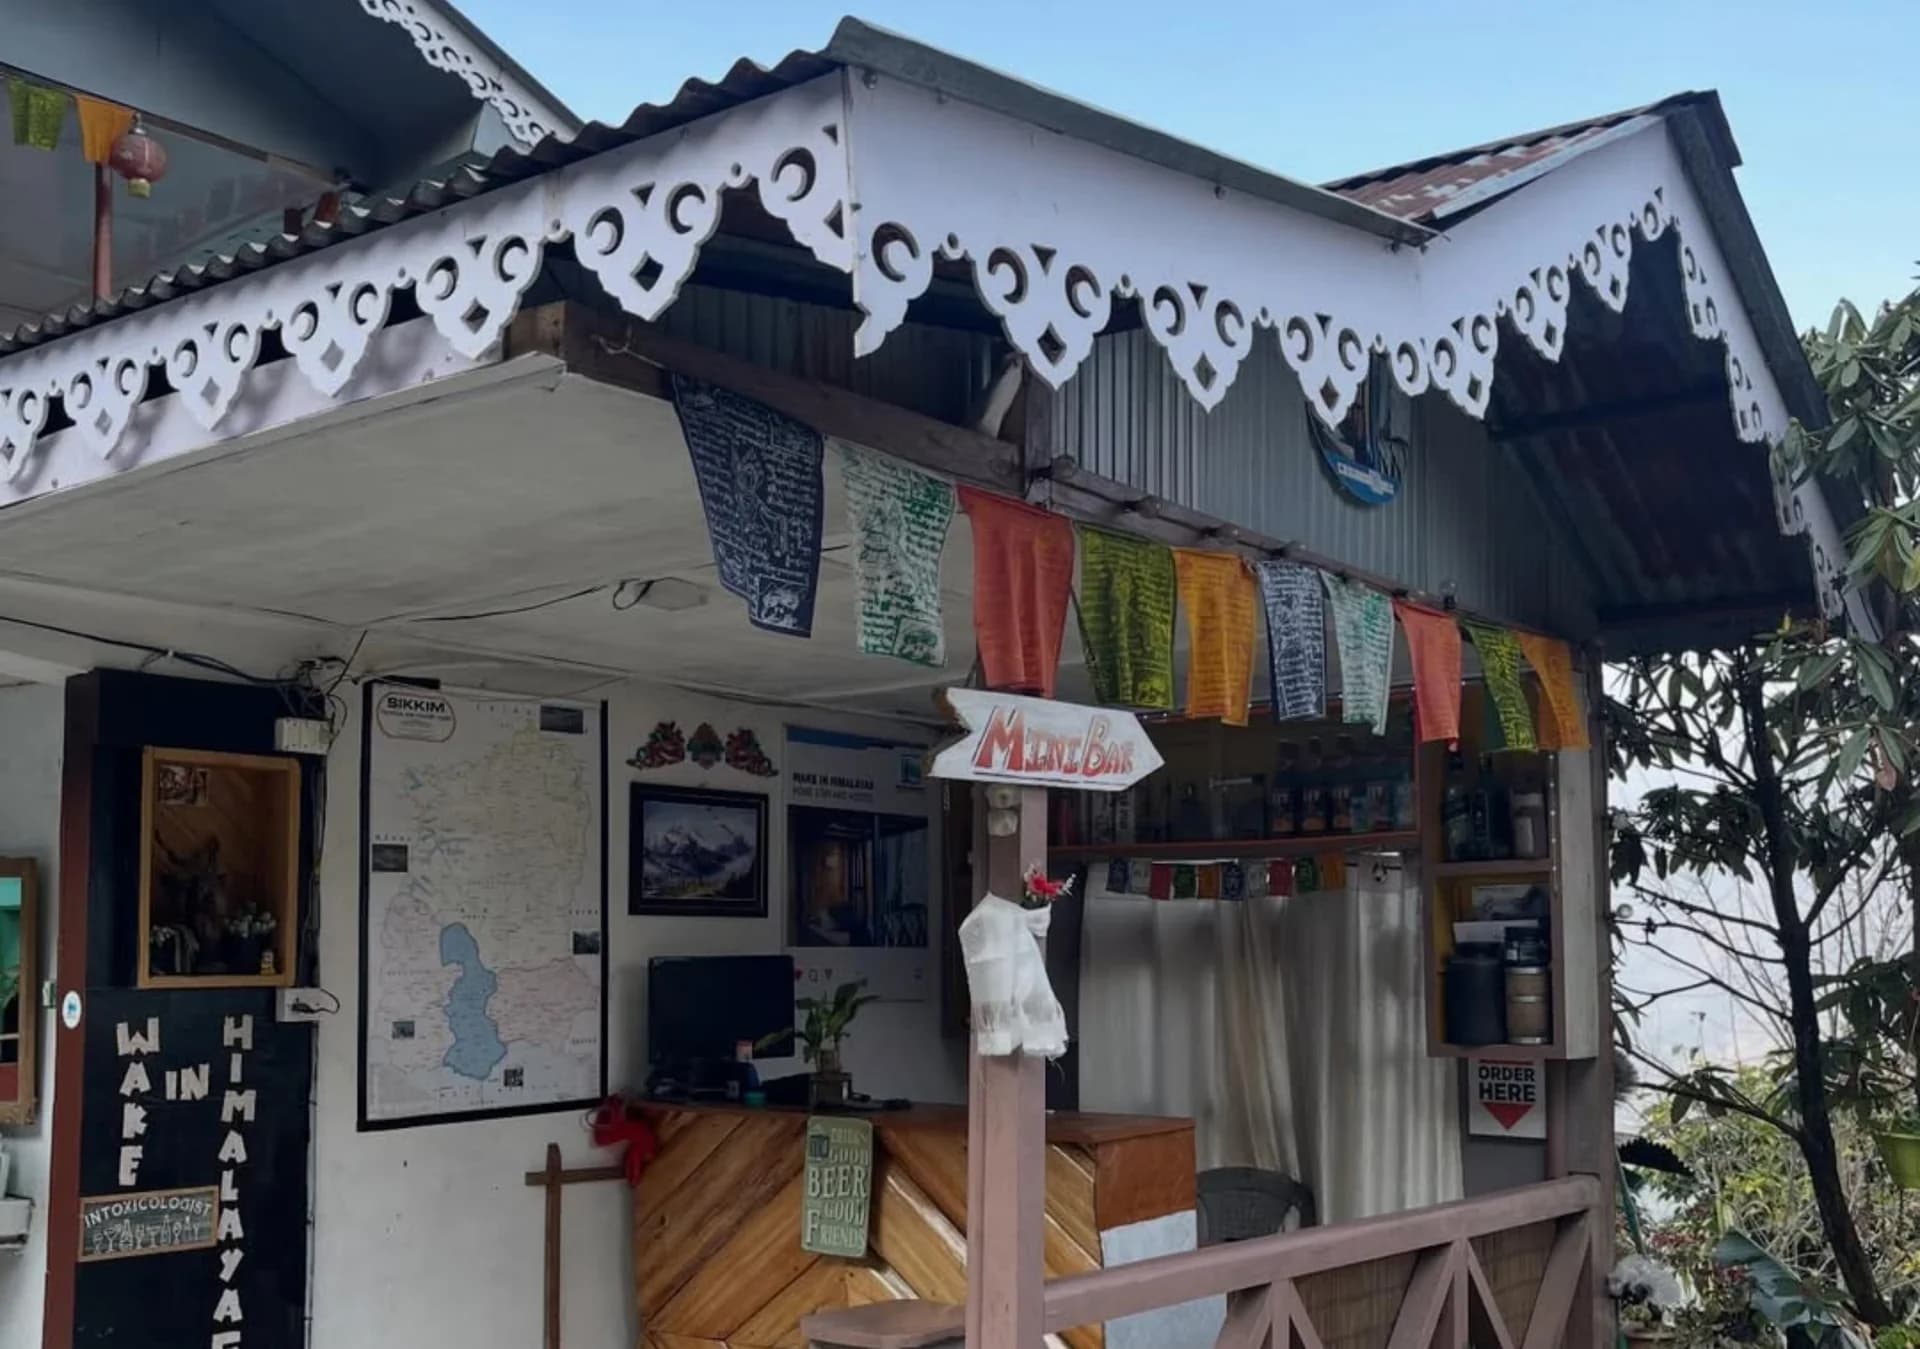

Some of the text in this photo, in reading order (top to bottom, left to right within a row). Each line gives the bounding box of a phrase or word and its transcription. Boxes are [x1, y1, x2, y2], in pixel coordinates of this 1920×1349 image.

[387, 697, 446, 713] SIKKIM
[165, 1063, 210, 1101] IN
[1478, 1066, 1536, 1082] ORDER
[116, 1016, 160, 1187] WAKE
[1478, 1083, 1537, 1102] HERE
[807, 1165, 867, 1199] BEER
[84, 1196, 212, 1229] INTOXICOLOGIST
[823, 1199, 866, 1226] GOOD
